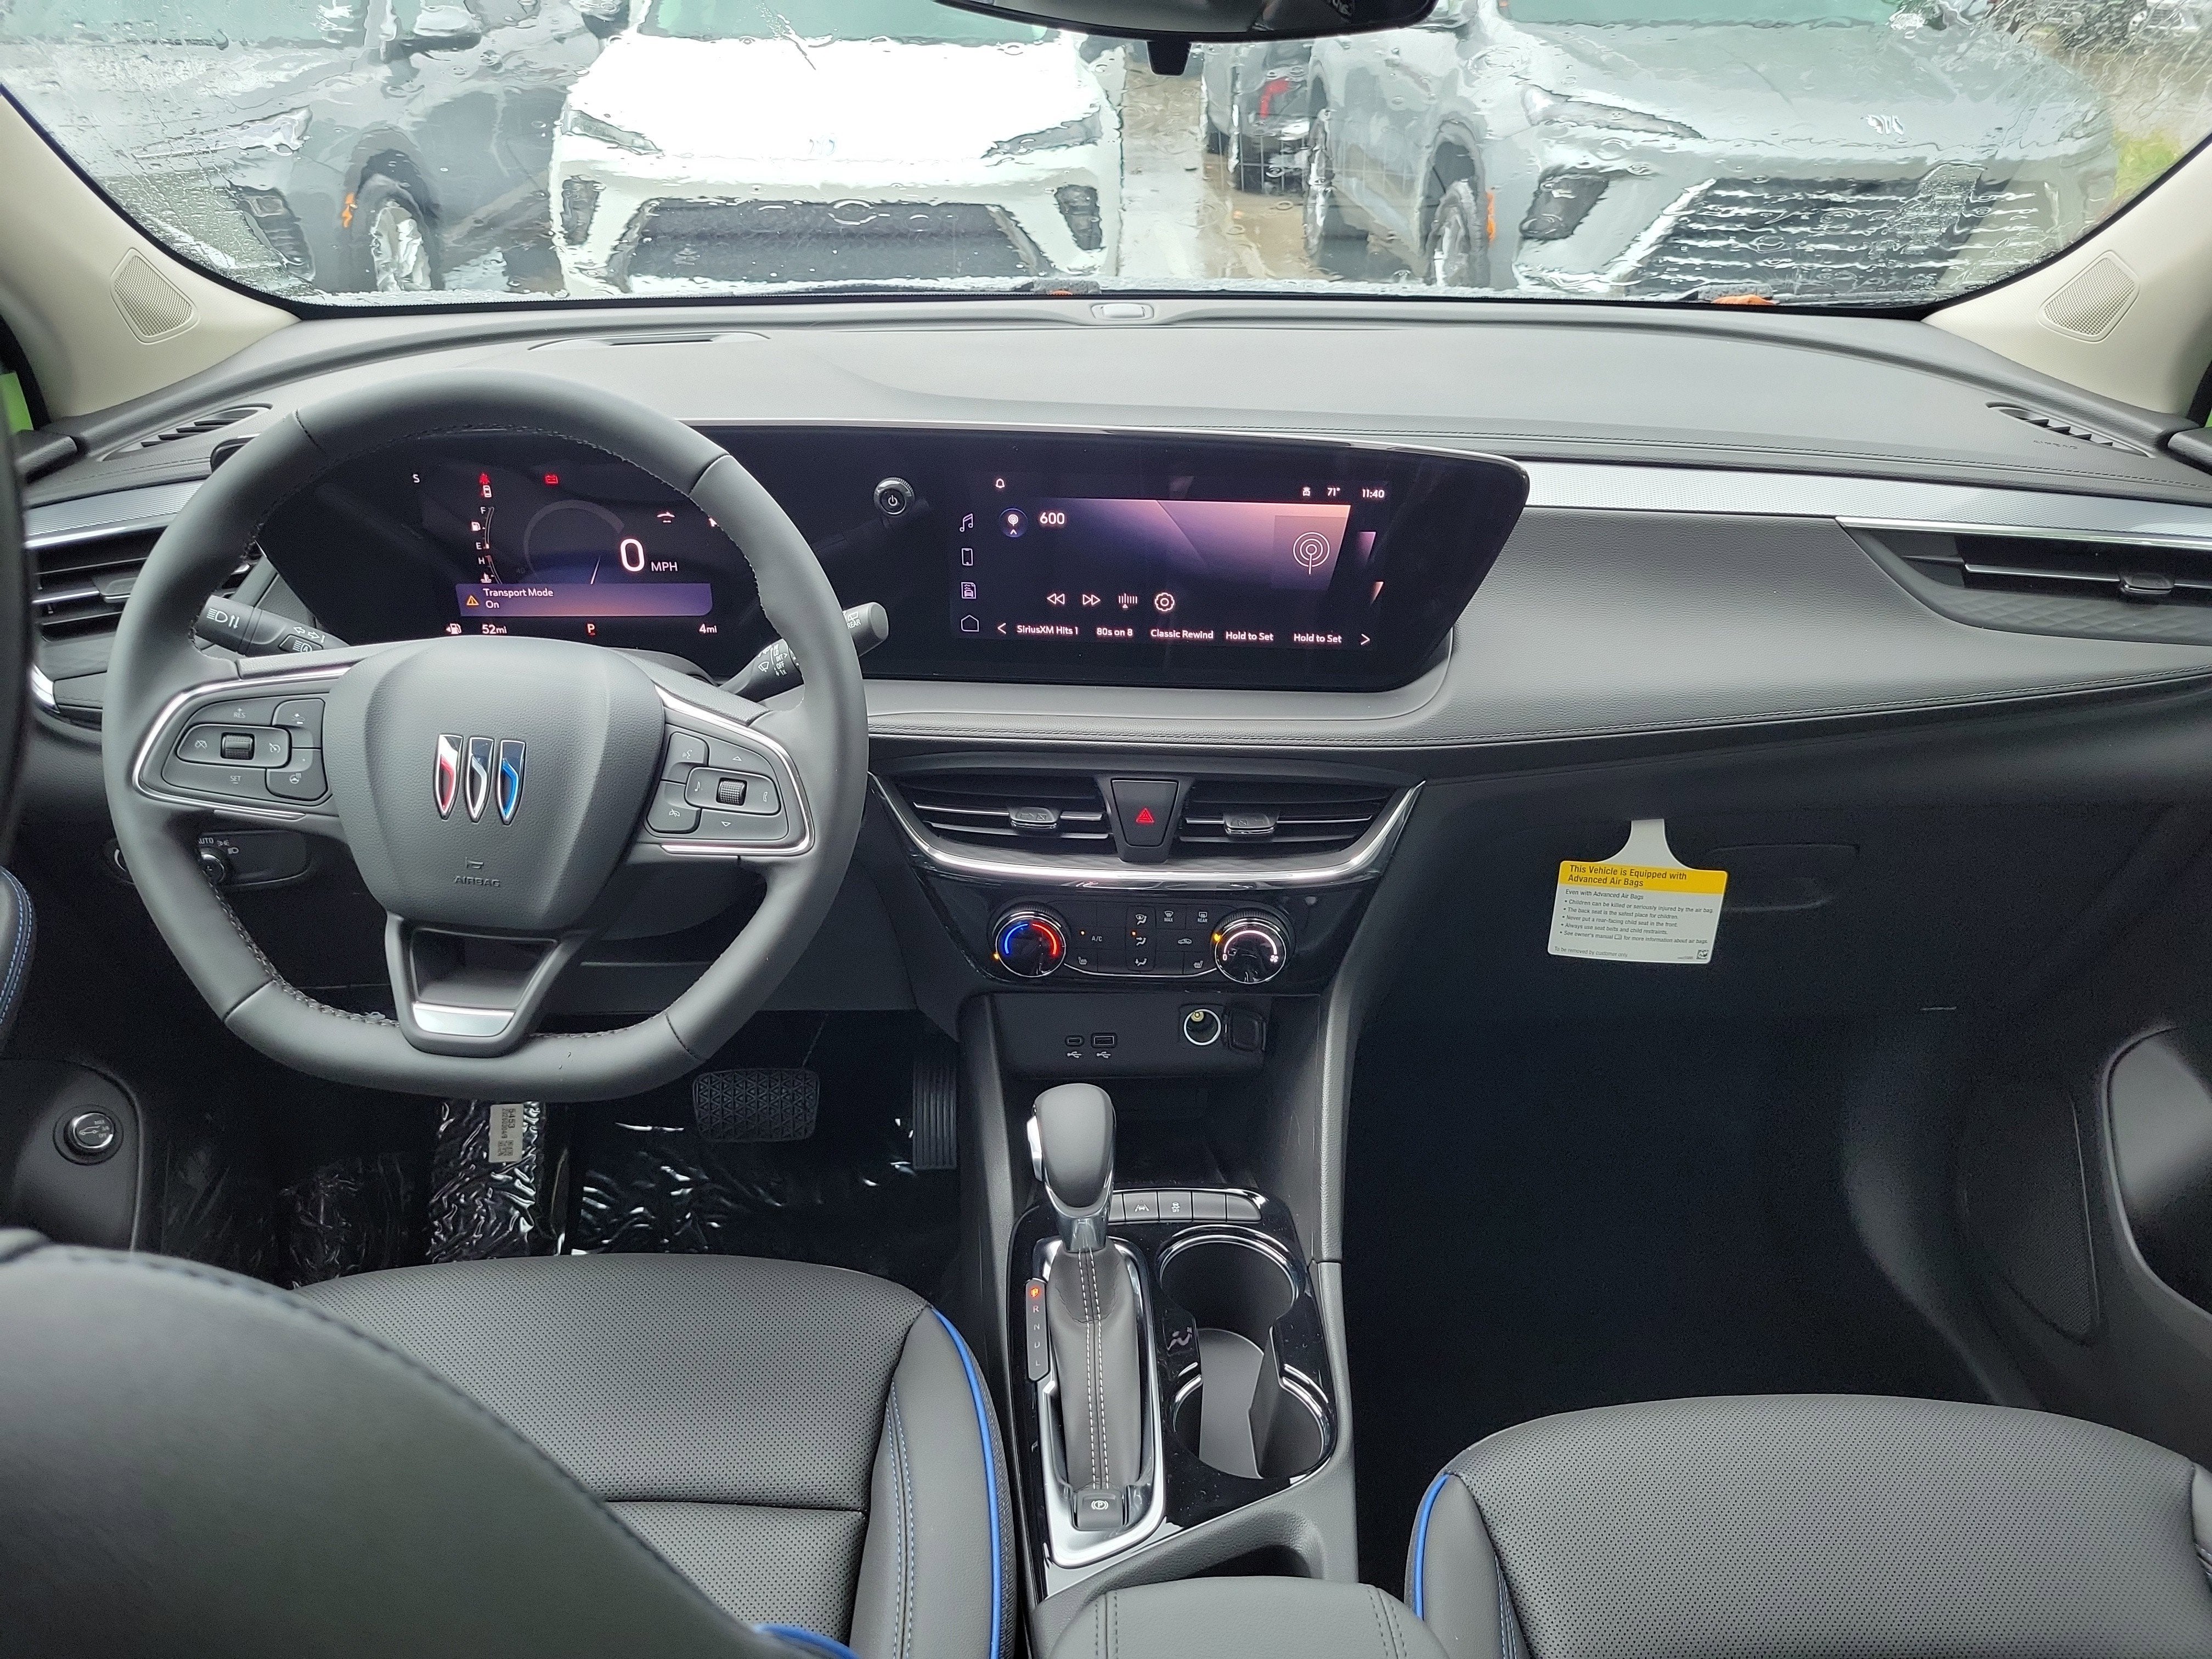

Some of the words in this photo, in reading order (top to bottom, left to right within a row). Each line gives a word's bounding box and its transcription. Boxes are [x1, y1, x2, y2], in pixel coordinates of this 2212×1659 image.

[413, 473, 420, 483] S
[1362, 489, 1385, 498] 11:40
[480, 506, 486, 515] F
[1040, 512, 1065, 525] 600
[620, 538, 645, 572] 0
[651, 561, 678, 572] MPH
[482, 588, 527, 598] Transport
[528, 588, 554, 597] Mode
[486, 600, 500, 608] On
[482, 624, 507, 634] 52mi
[586, 623, 595, 633] P
[699, 623, 718, 634] 4mi
[847, 619, 861, 629] REAR
[1017, 625, 1054, 634] SiriusXM
[1056, 626, 1073, 635] Hits
[1075, 627, 1079, 635] 1
[1096, 627, 1113, 636] 80s
[1150, 628, 1181, 638] Classic
[1182, 630, 1214, 639] Rewind
[1226, 631, 1246, 640] Hold
[1259, 632, 1274, 641] Set
[1294, 633, 1314, 642] Hold
[1327, 635, 1342, 643] Set
[776, 661, 785, 669] OFF
[1570, 865, 1586, 873] This
[1589, 866, 1618, 876] Vehicle
[1620, 868, 1627, 876] is
[1629, 868, 1667, 879] Equipped
[1669, 871, 1687, 880] with
[454, 876, 500, 887] AIRBAG
[1568, 874, 1607, 884] Advanced
[1610, 877, 1621, 885] Air
[1623, 878, 1644, 888] Bags
